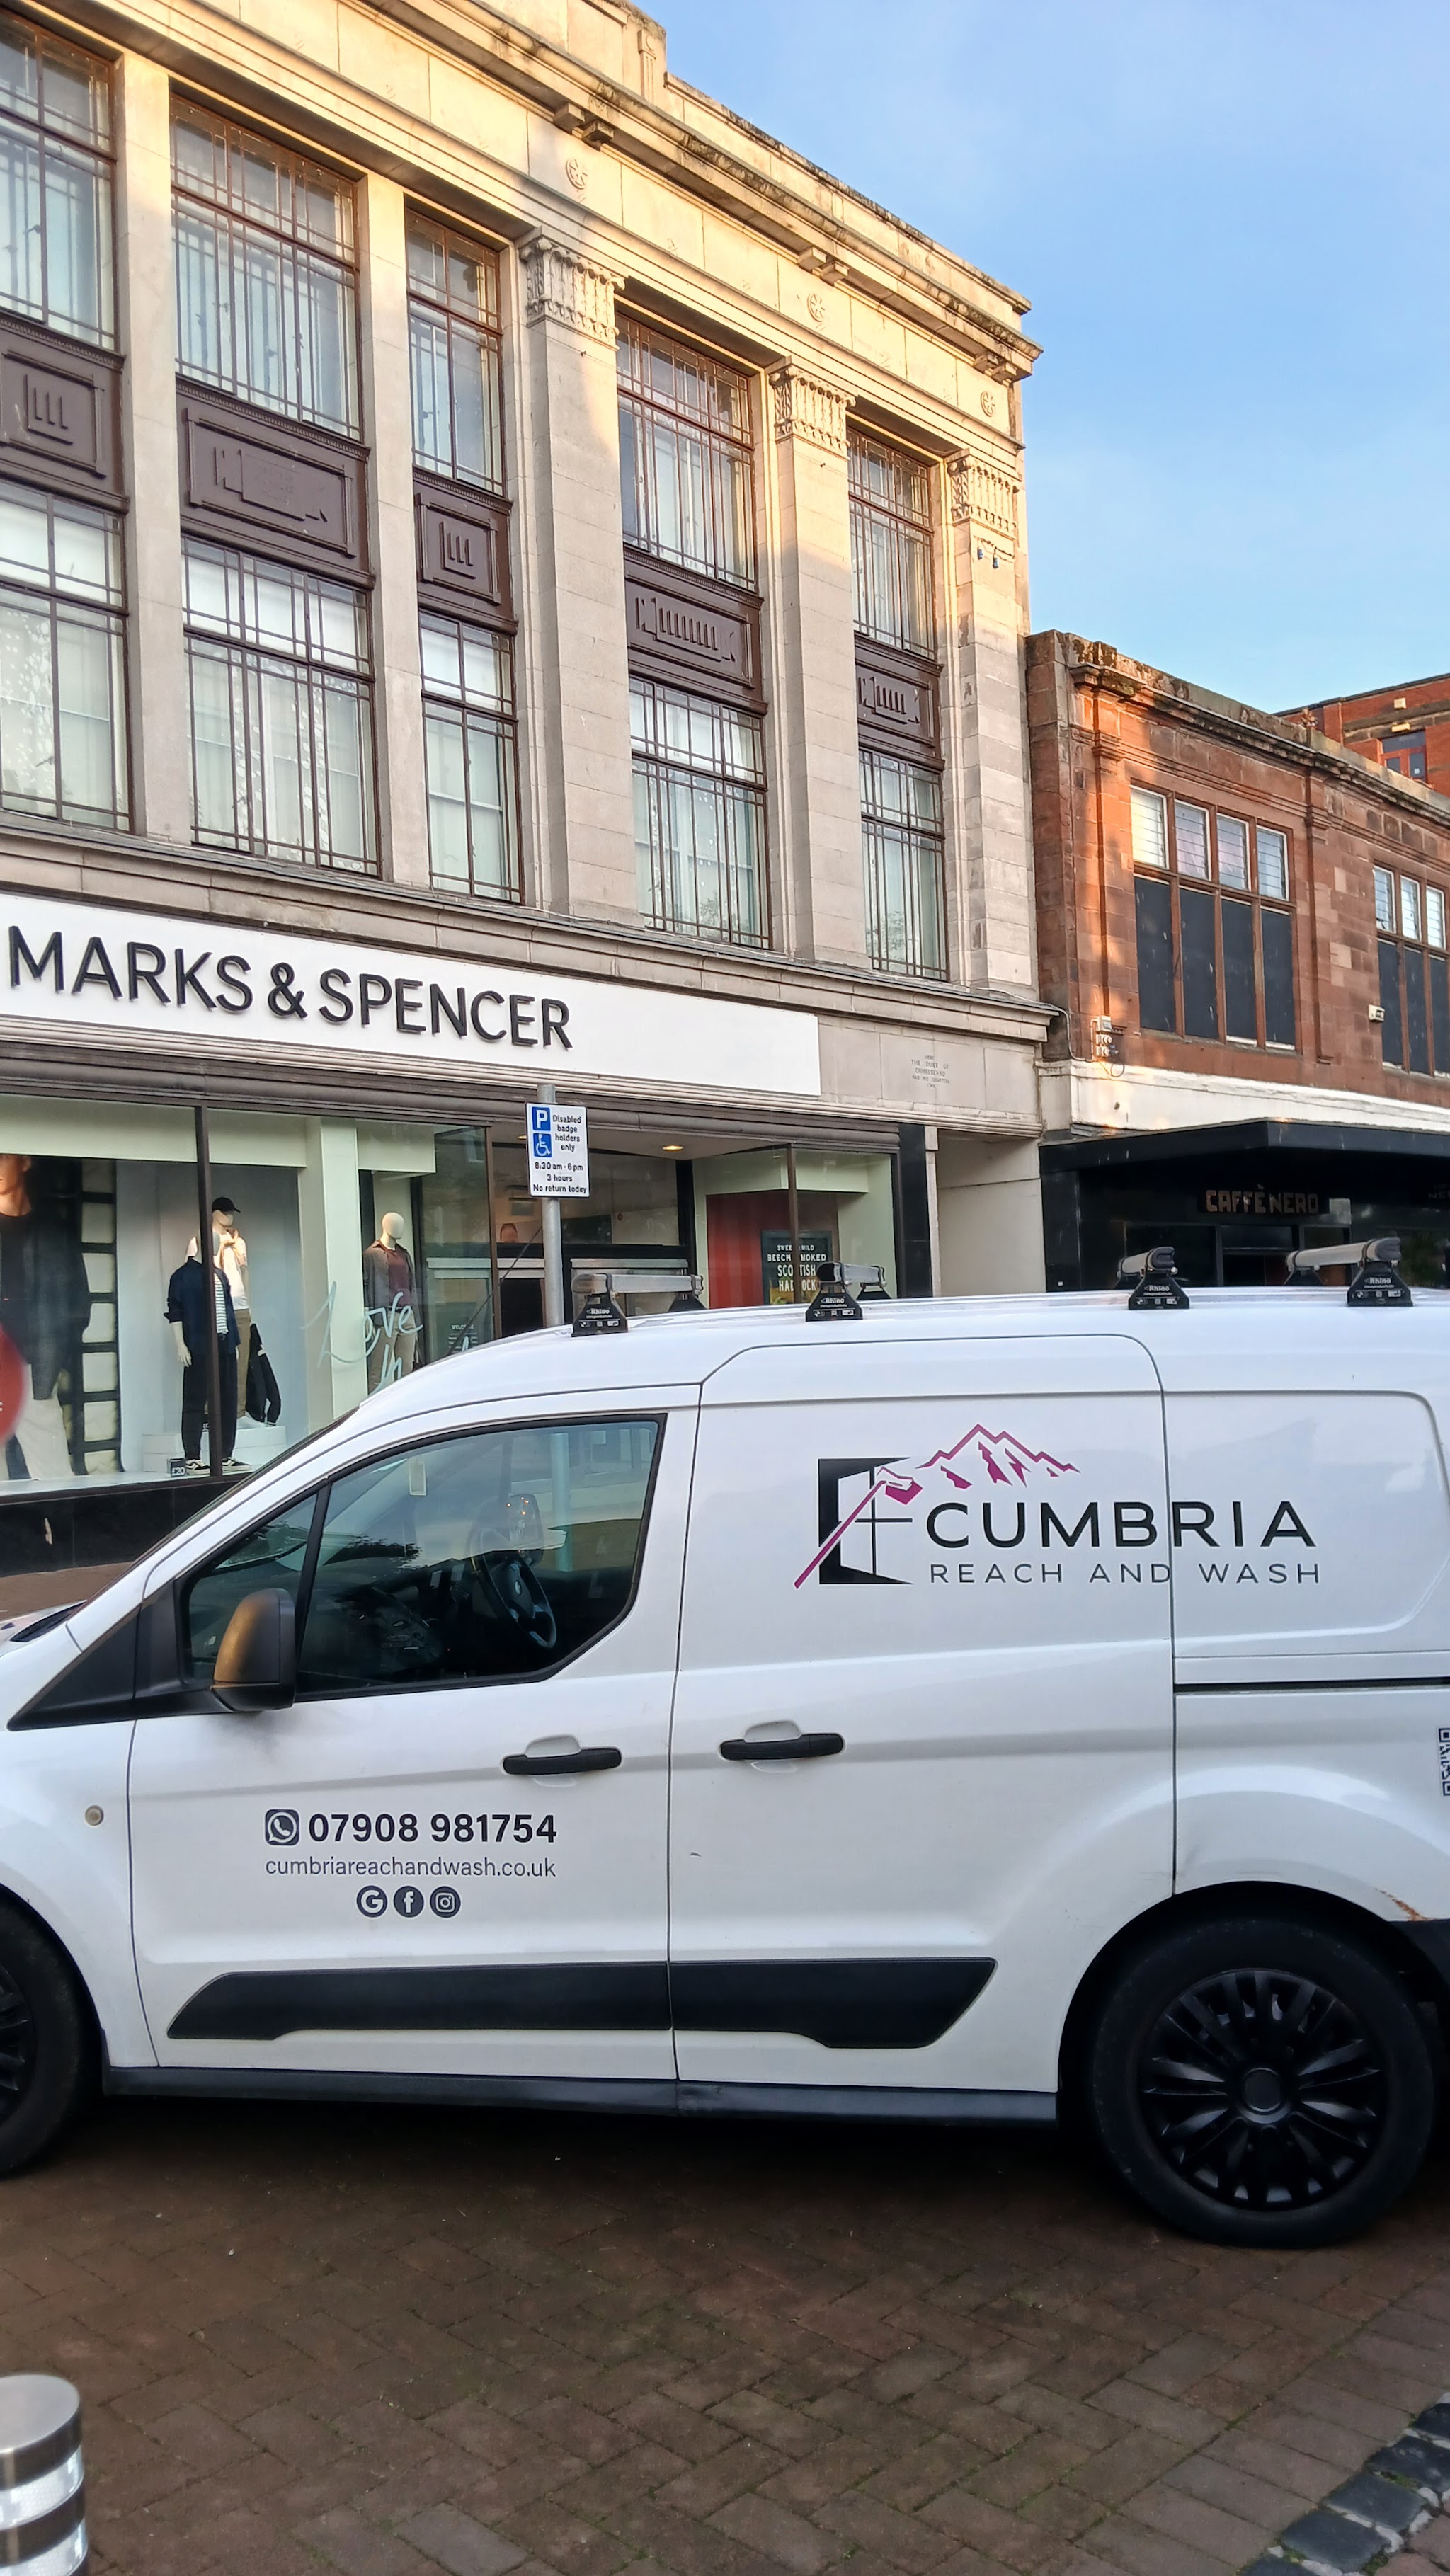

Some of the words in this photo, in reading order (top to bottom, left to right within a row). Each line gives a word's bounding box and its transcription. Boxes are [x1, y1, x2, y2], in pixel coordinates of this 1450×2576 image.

[552, 1114, 581, 1123] Disabled
[557, 1124, 578, 1133] badge
[555, 1133, 581, 1142] holders
[561, 1143, 576, 1152] only
[553, 1174, 573, 1182] hours
[569, 1185, 587, 1194] today
[1206, 1184, 1267, 1213] CAFFÈ
[1269, 1192, 1319, 1213] NERO
[777, 1264, 816, 1277] SCOTISH
[926, 1501, 1317, 1548] CUMBRIA
[930, 1563, 1062, 1583] REACH
[1089, 1563, 1170, 1583] AND
[1199, 1563, 1319, 1584] WASH
[309, 1814, 418, 1842] 07908
[430, 1814, 557, 1843] 981754
[266, 1856, 556, 1877] cumbriareachandwash.co.uk
